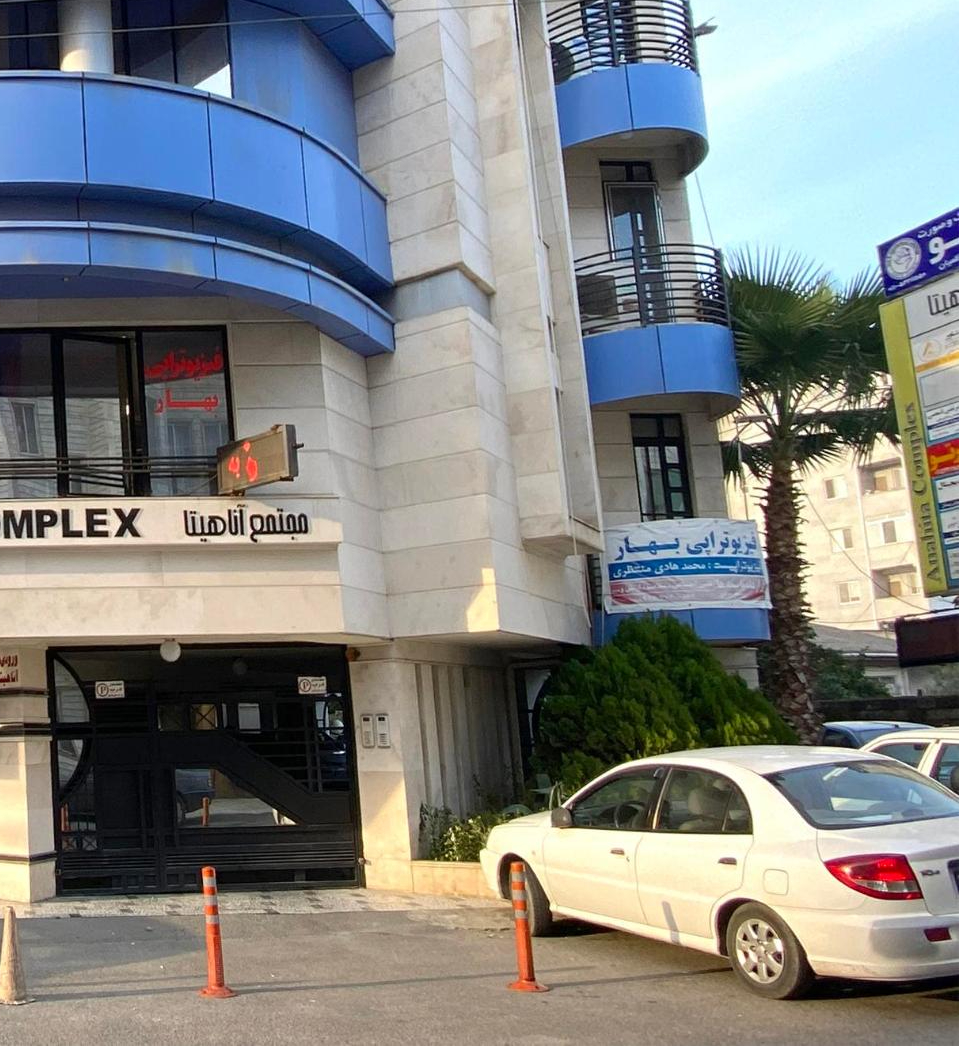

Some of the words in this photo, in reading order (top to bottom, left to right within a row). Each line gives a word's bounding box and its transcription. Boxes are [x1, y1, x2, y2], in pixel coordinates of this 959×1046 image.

[183, 503, 245, 543] آناهیتا
[249, 507, 310, 544] مجتمع
[614, 535, 681, 562] بهار
[686, 530, 758, 557] فیزیوتراپی
[612, 564, 652, 579] منتظری
[654, 561, 680, 575] هادی
[680, 562, 707, 571] محمد
